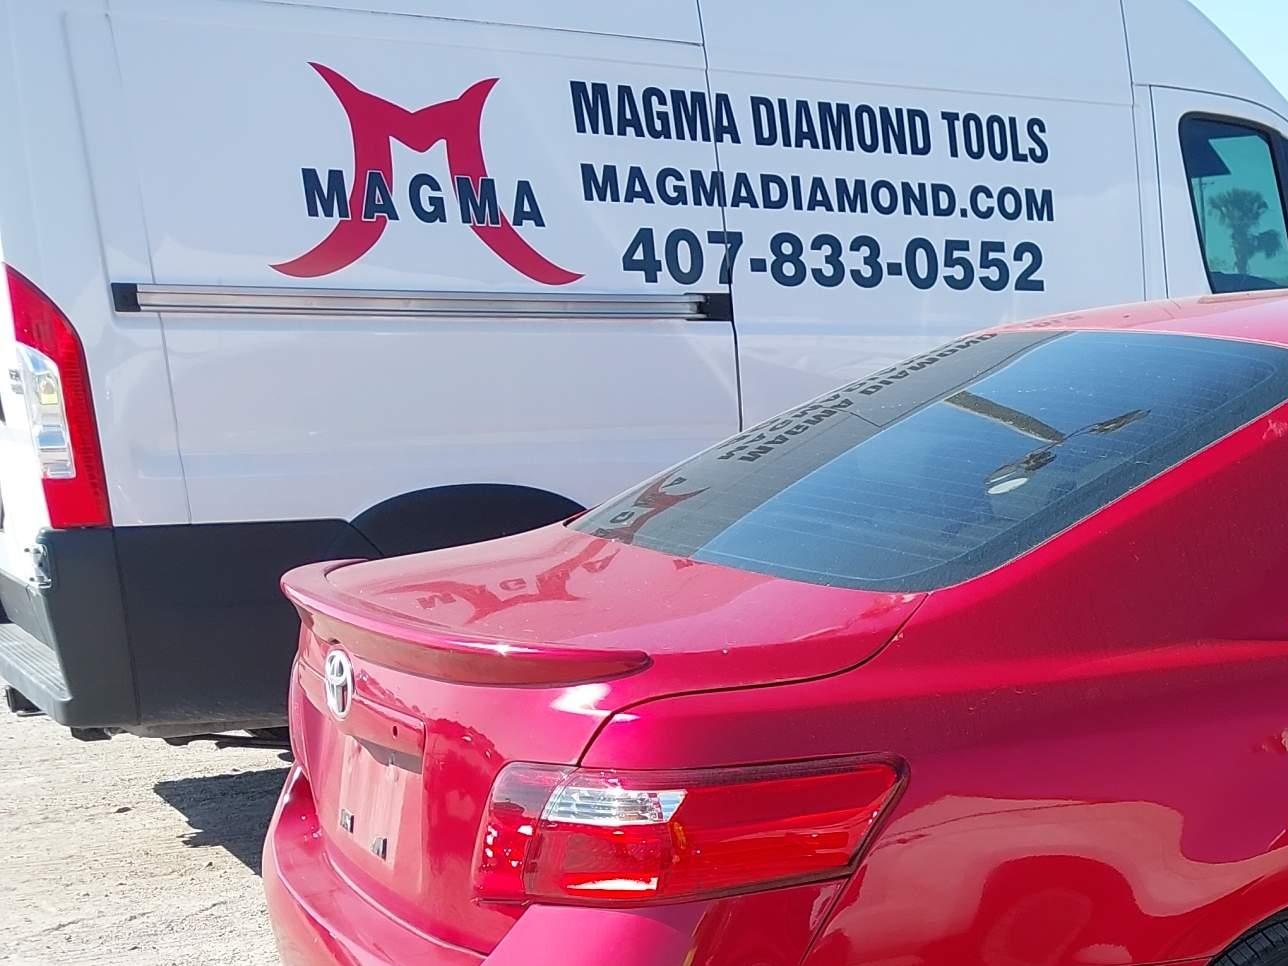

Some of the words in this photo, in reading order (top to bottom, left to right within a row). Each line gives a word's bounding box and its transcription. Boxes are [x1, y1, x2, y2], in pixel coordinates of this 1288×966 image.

[569, 80, 741, 145] MAGMA
[749, 95, 932, 157] DIAMOND
[940, 110, 1049, 164] TOOLS
[301, 167, 547, 229] MAGMA
[579, 162, 1055, 222] MAGMADIAMOND.COM
[621, 227, 1045, 292] 407-833-0552
